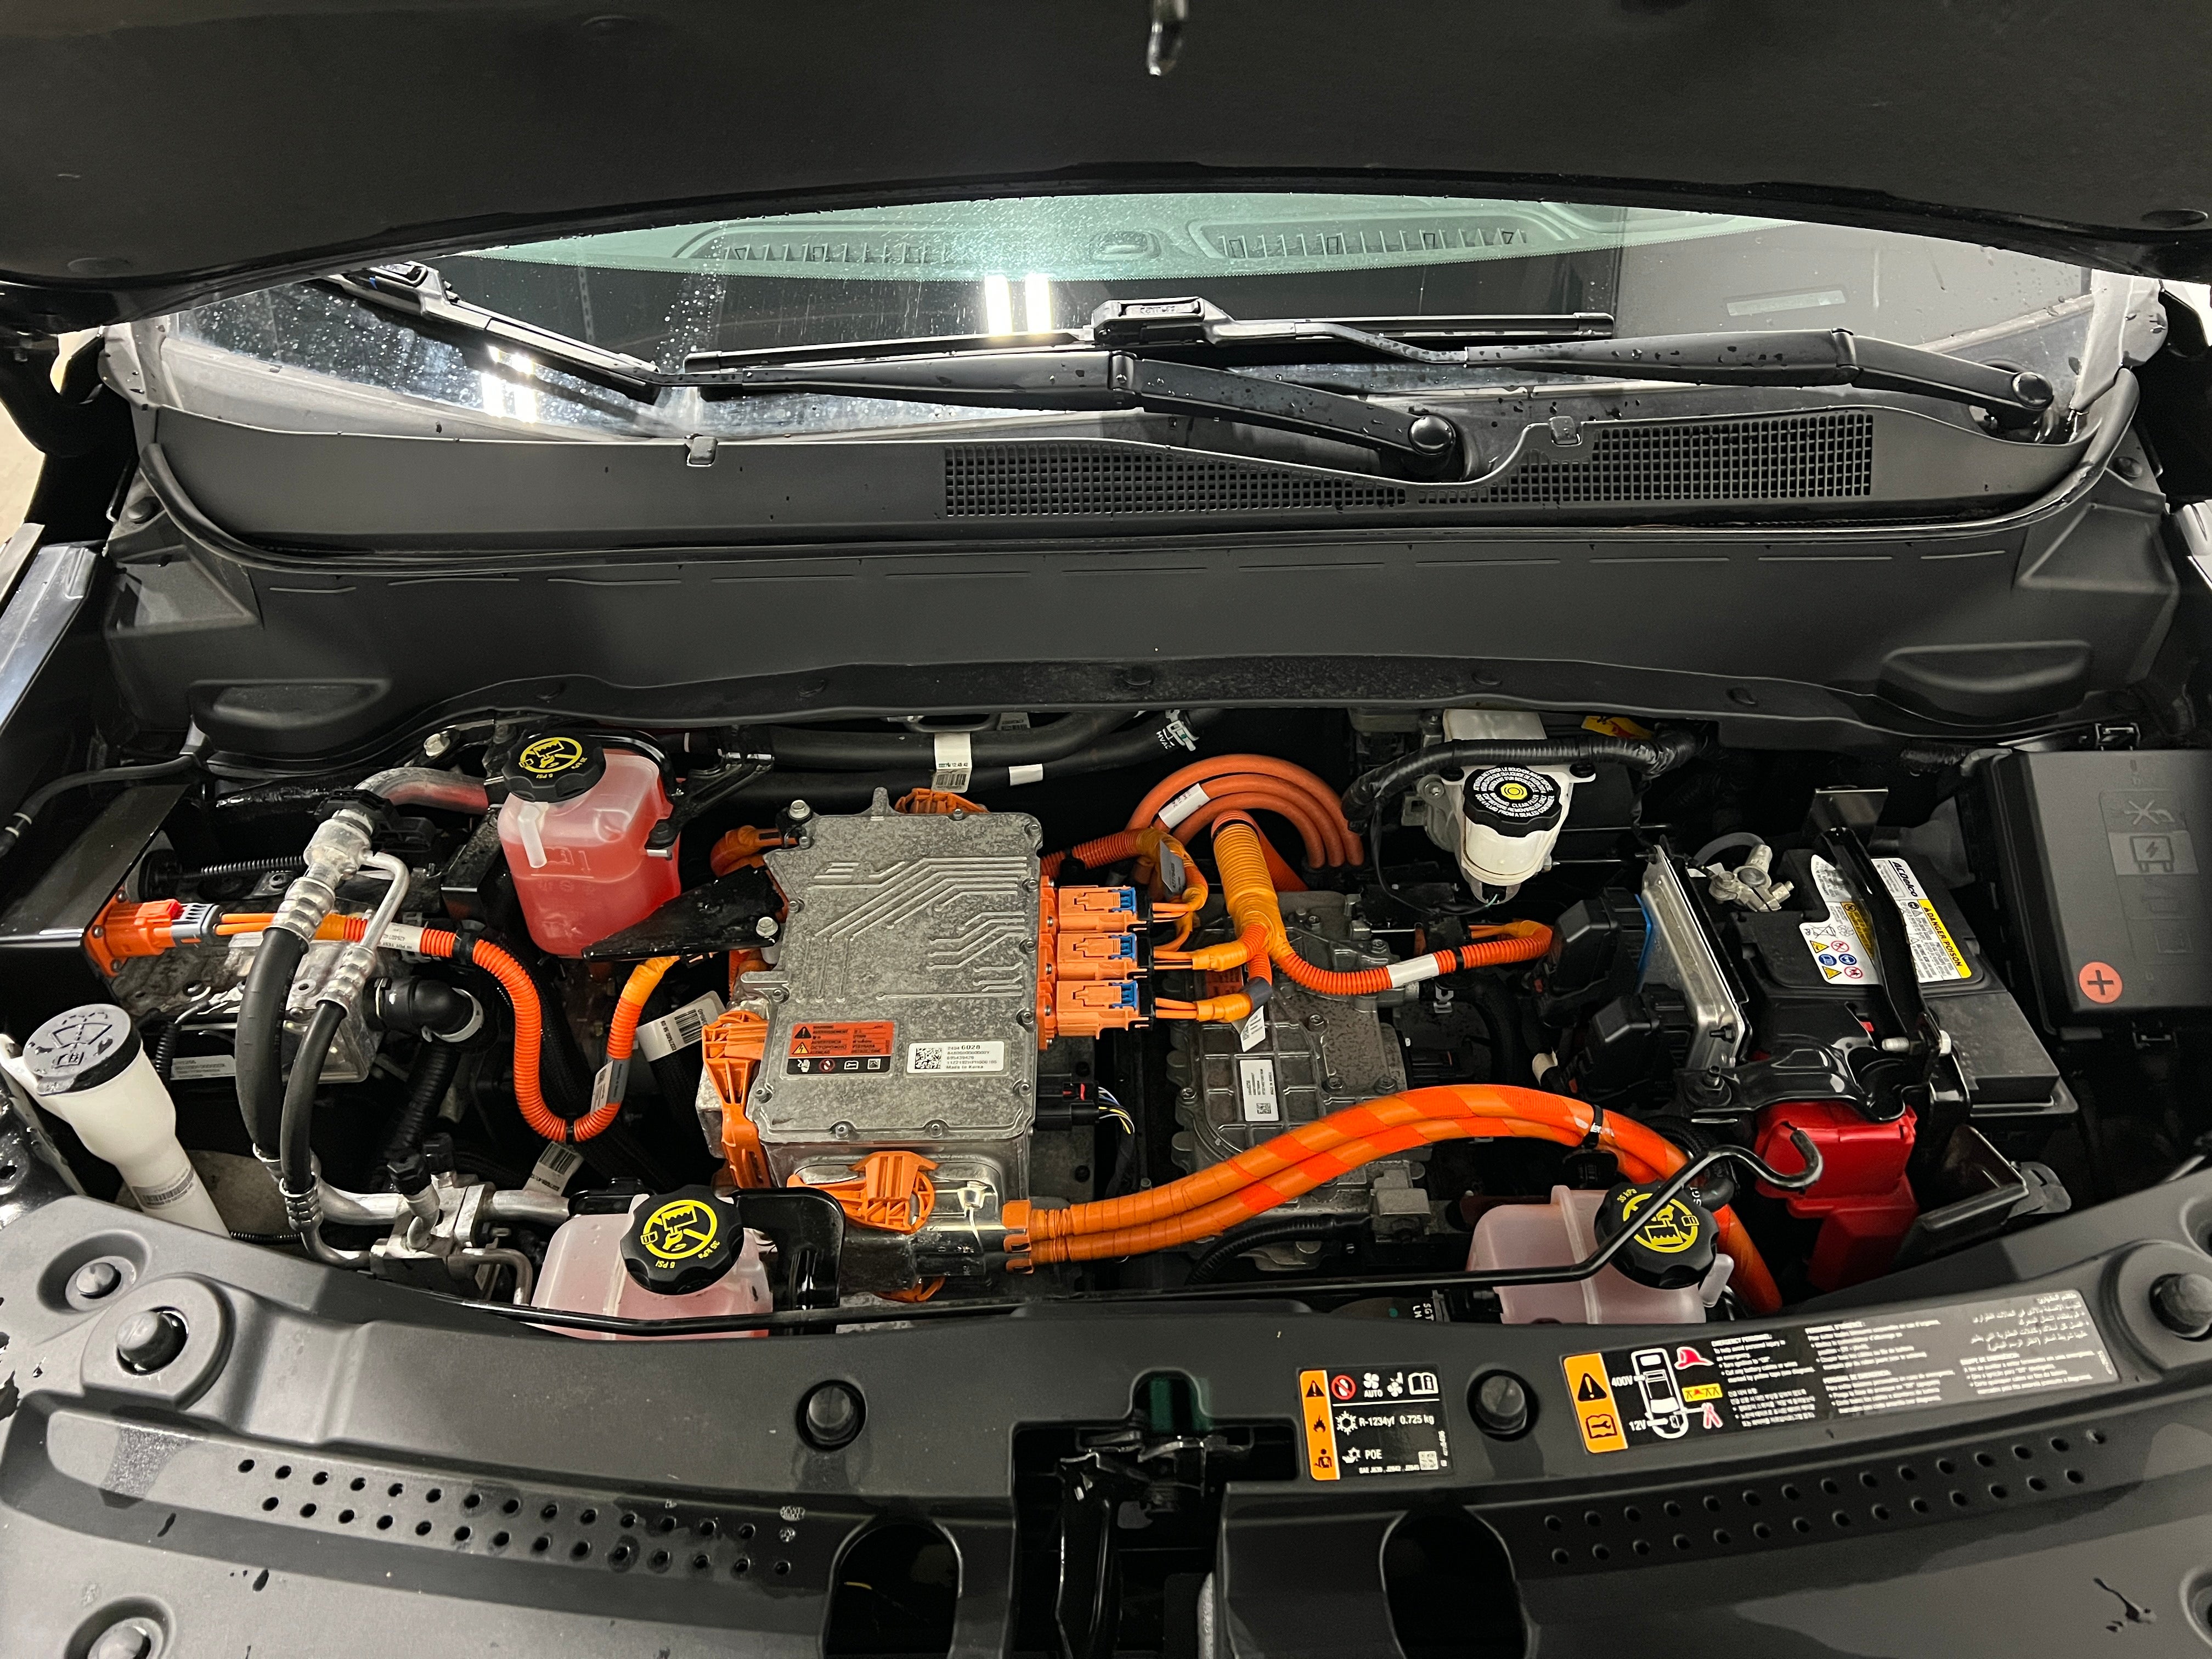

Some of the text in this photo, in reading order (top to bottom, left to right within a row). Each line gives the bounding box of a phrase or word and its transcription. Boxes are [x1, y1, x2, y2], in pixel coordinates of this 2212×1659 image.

[1156, 731, 1172, 749] HVAC
[1484, 803, 1499, 811] FLUID
[1892, 861, 1918, 897] ACDelco
[1927, 913, 1963, 966] DANGER/POISON
[1623, 1188, 1637, 1197] kPa
[697, 1248, 713, 1259] kPa
[656, 1260, 668, 1268] PSI
[1423, 1303, 1434, 1321] SGT
[1611, 1376, 1633, 1387] 400V
[1364, 1389, 1383, 1397] AUTO
[1359, 1414, 1435, 1427] R-1234yf 0.725 kg
[1629, 1420, 1646, 1431] 12V
[1364, 1449, 1383, 1460] POE
